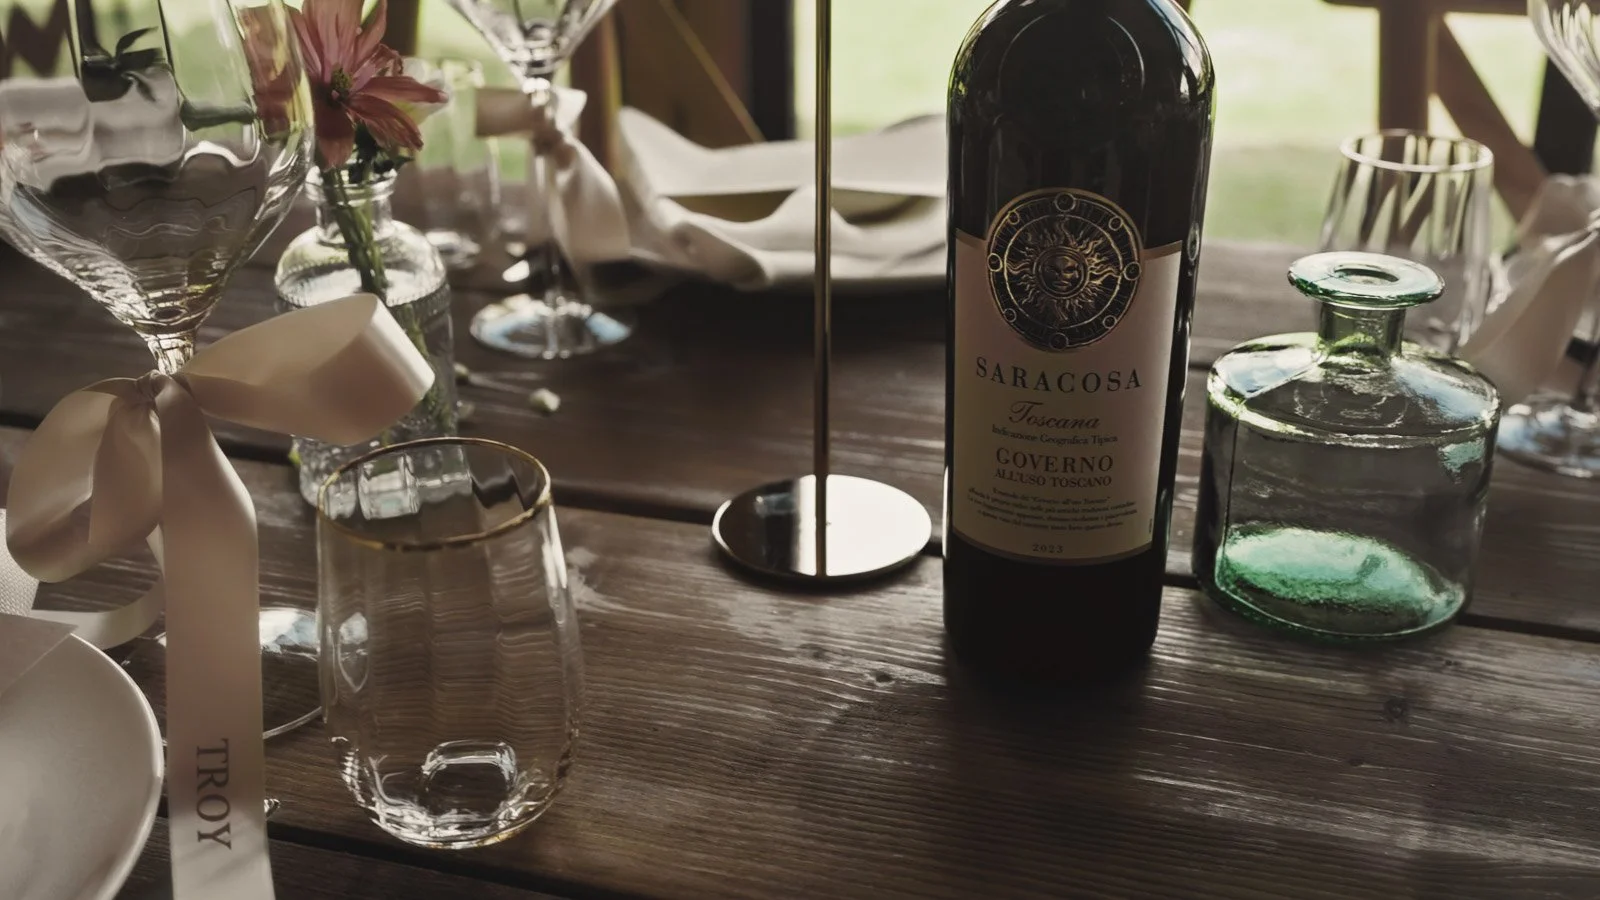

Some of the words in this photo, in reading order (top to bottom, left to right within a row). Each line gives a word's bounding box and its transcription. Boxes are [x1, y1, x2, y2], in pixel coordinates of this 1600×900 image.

[976, 356, 1142, 394] SARACOSA
[1008, 400, 1100, 429] Toscana
[996, 447, 1113, 472] GOVERNO
[994, 468, 1046, 486] ALL'USO
[1049, 475, 1112, 488] TOSCANO
[1032, 543, 1064, 553] 2023
[196, 738, 232, 850] TROY
